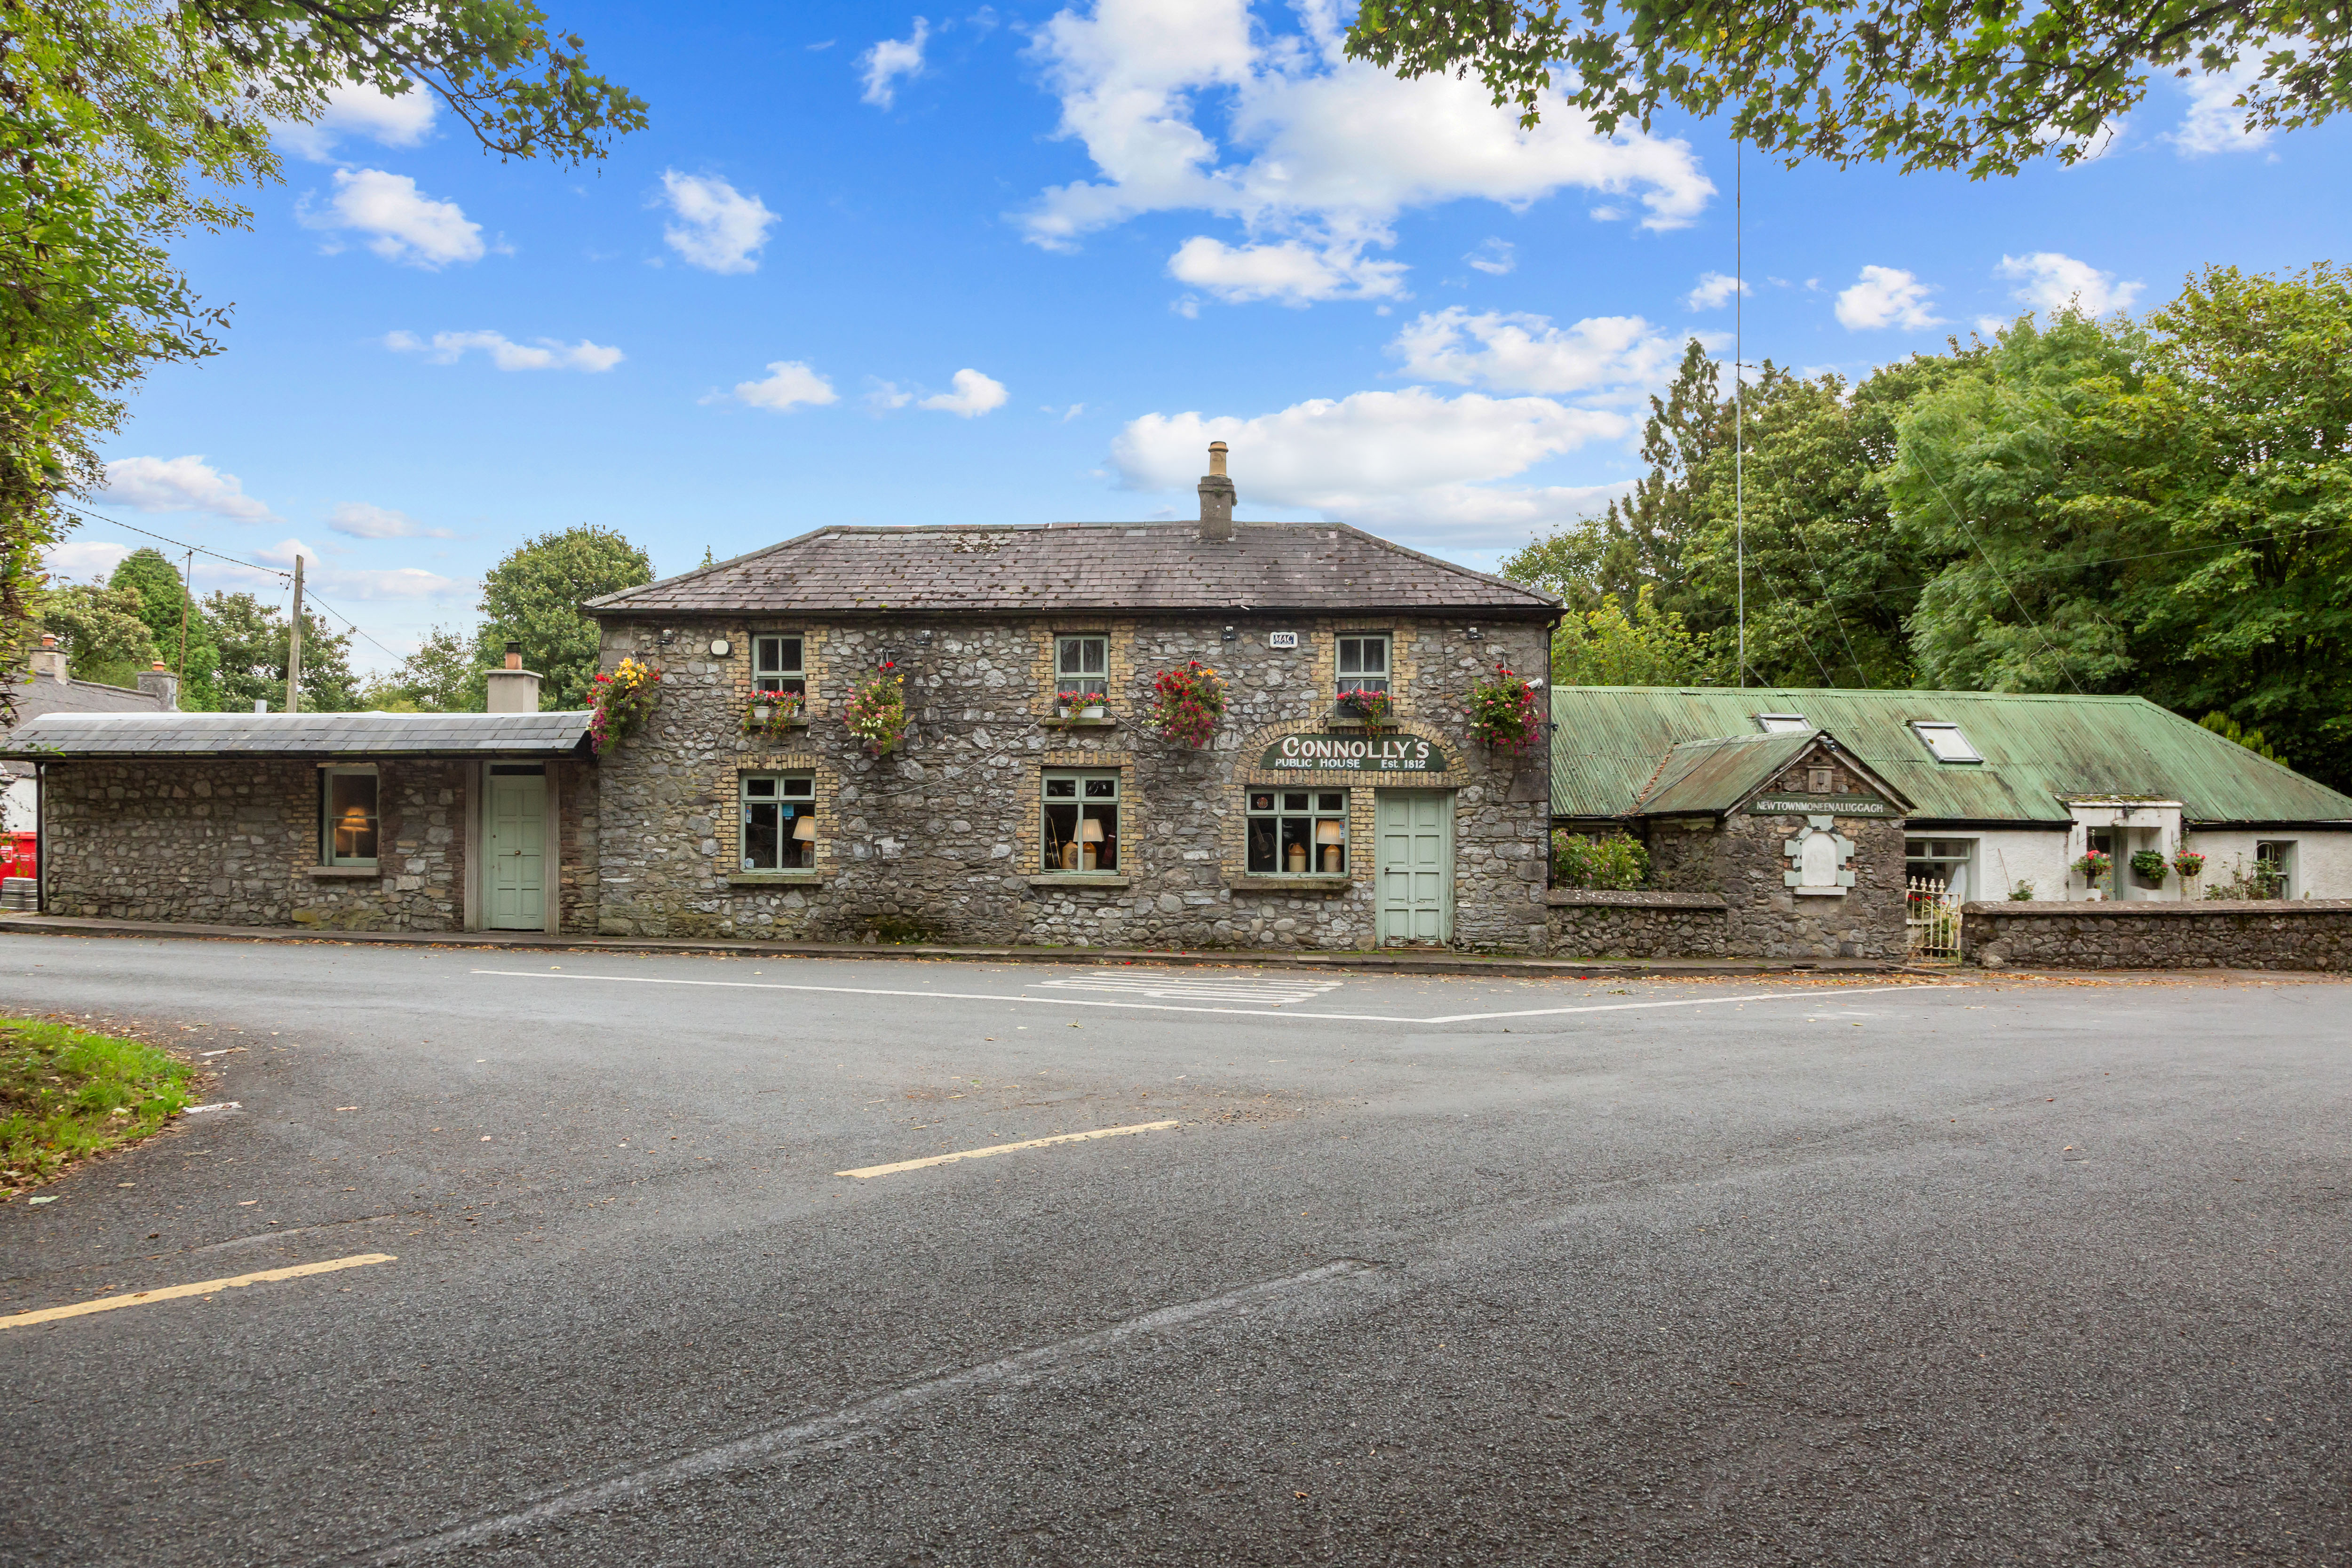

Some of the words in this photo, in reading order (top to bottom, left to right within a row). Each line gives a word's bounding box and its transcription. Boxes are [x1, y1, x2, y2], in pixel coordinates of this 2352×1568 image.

[1281, 737, 1430, 759] CONNOLLY'S
[1275, 758, 1312, 768] PUBLIC
[1320, 759, 1360, 768] HOUSE
[1381, 759, 1400, 769] Est.
[1404, 760, 1426, 769] 1812
